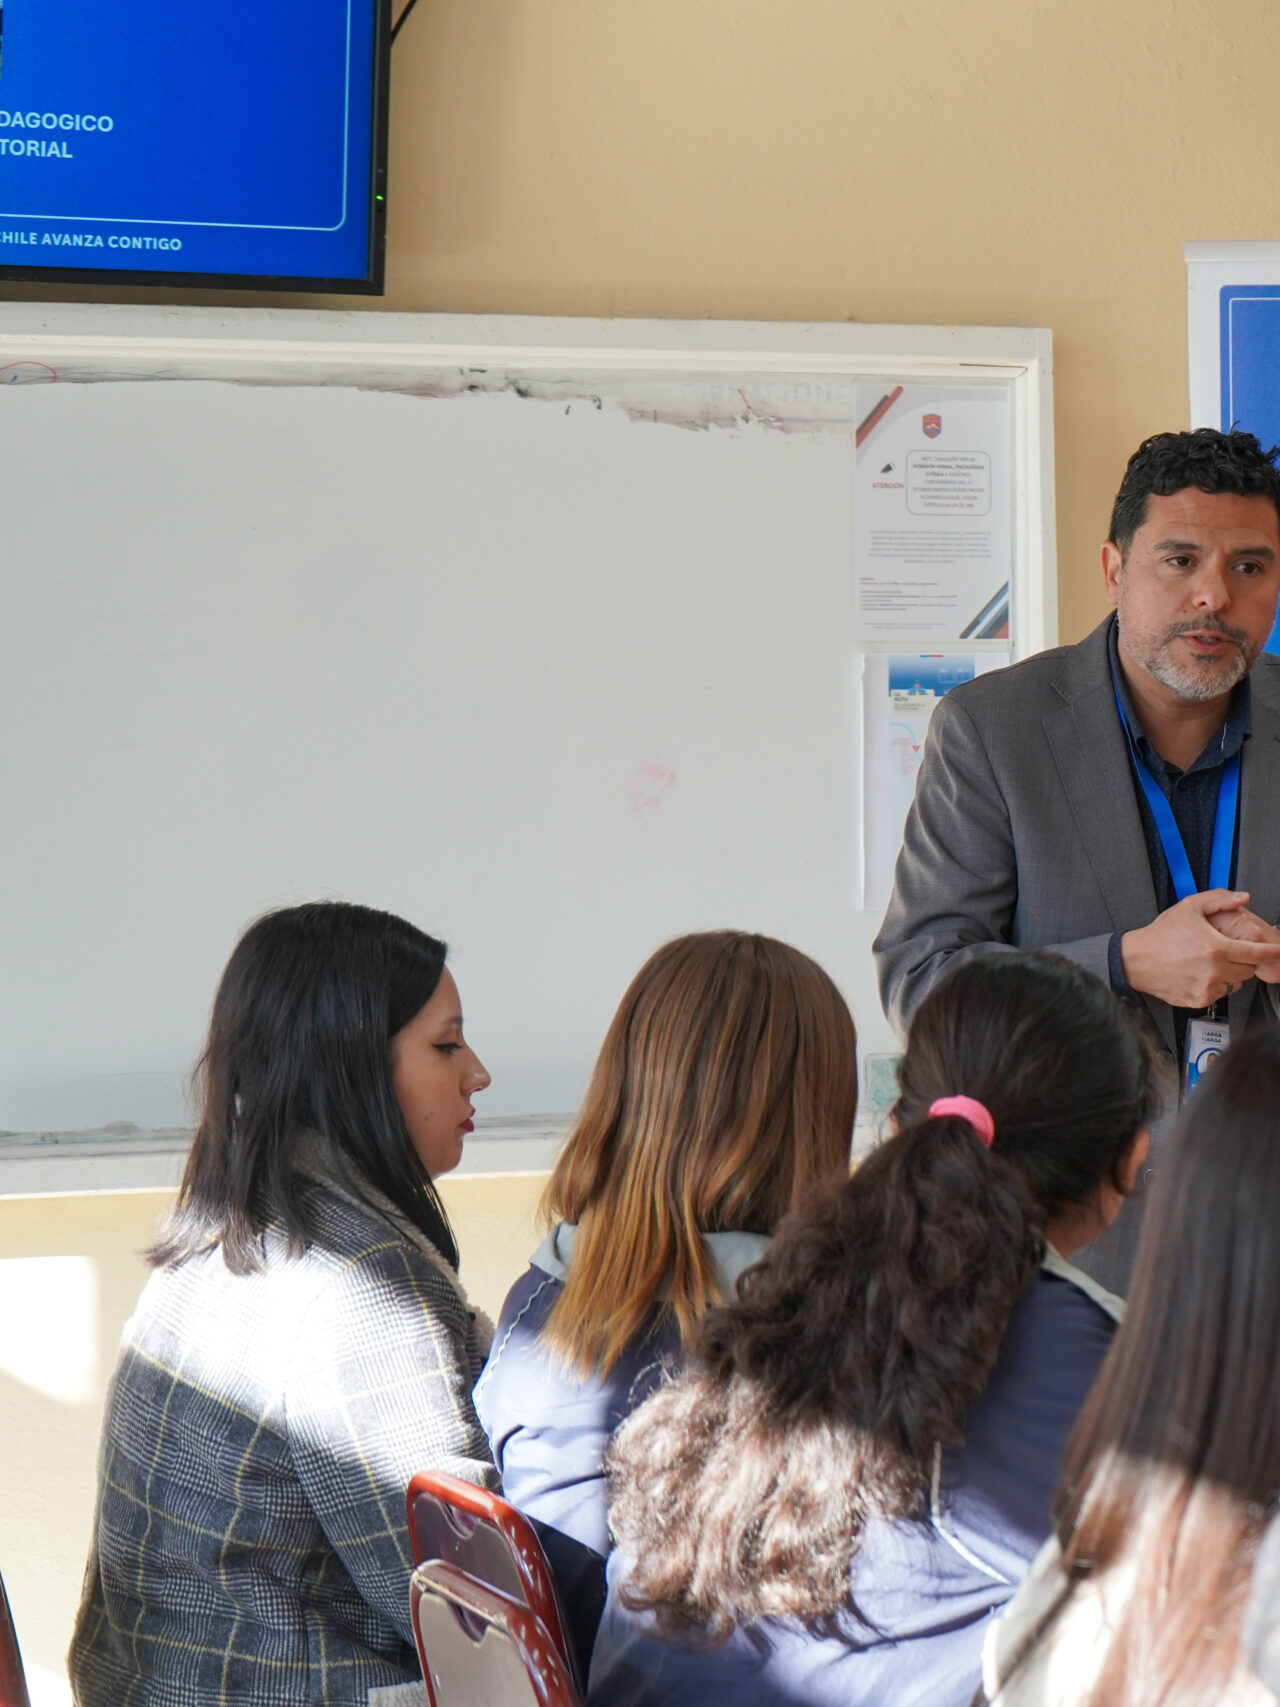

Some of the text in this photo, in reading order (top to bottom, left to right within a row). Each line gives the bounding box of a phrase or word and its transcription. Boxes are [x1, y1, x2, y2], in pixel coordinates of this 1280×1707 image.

[0, 231, 182, 251] HILE AVANZA CONTIGO
